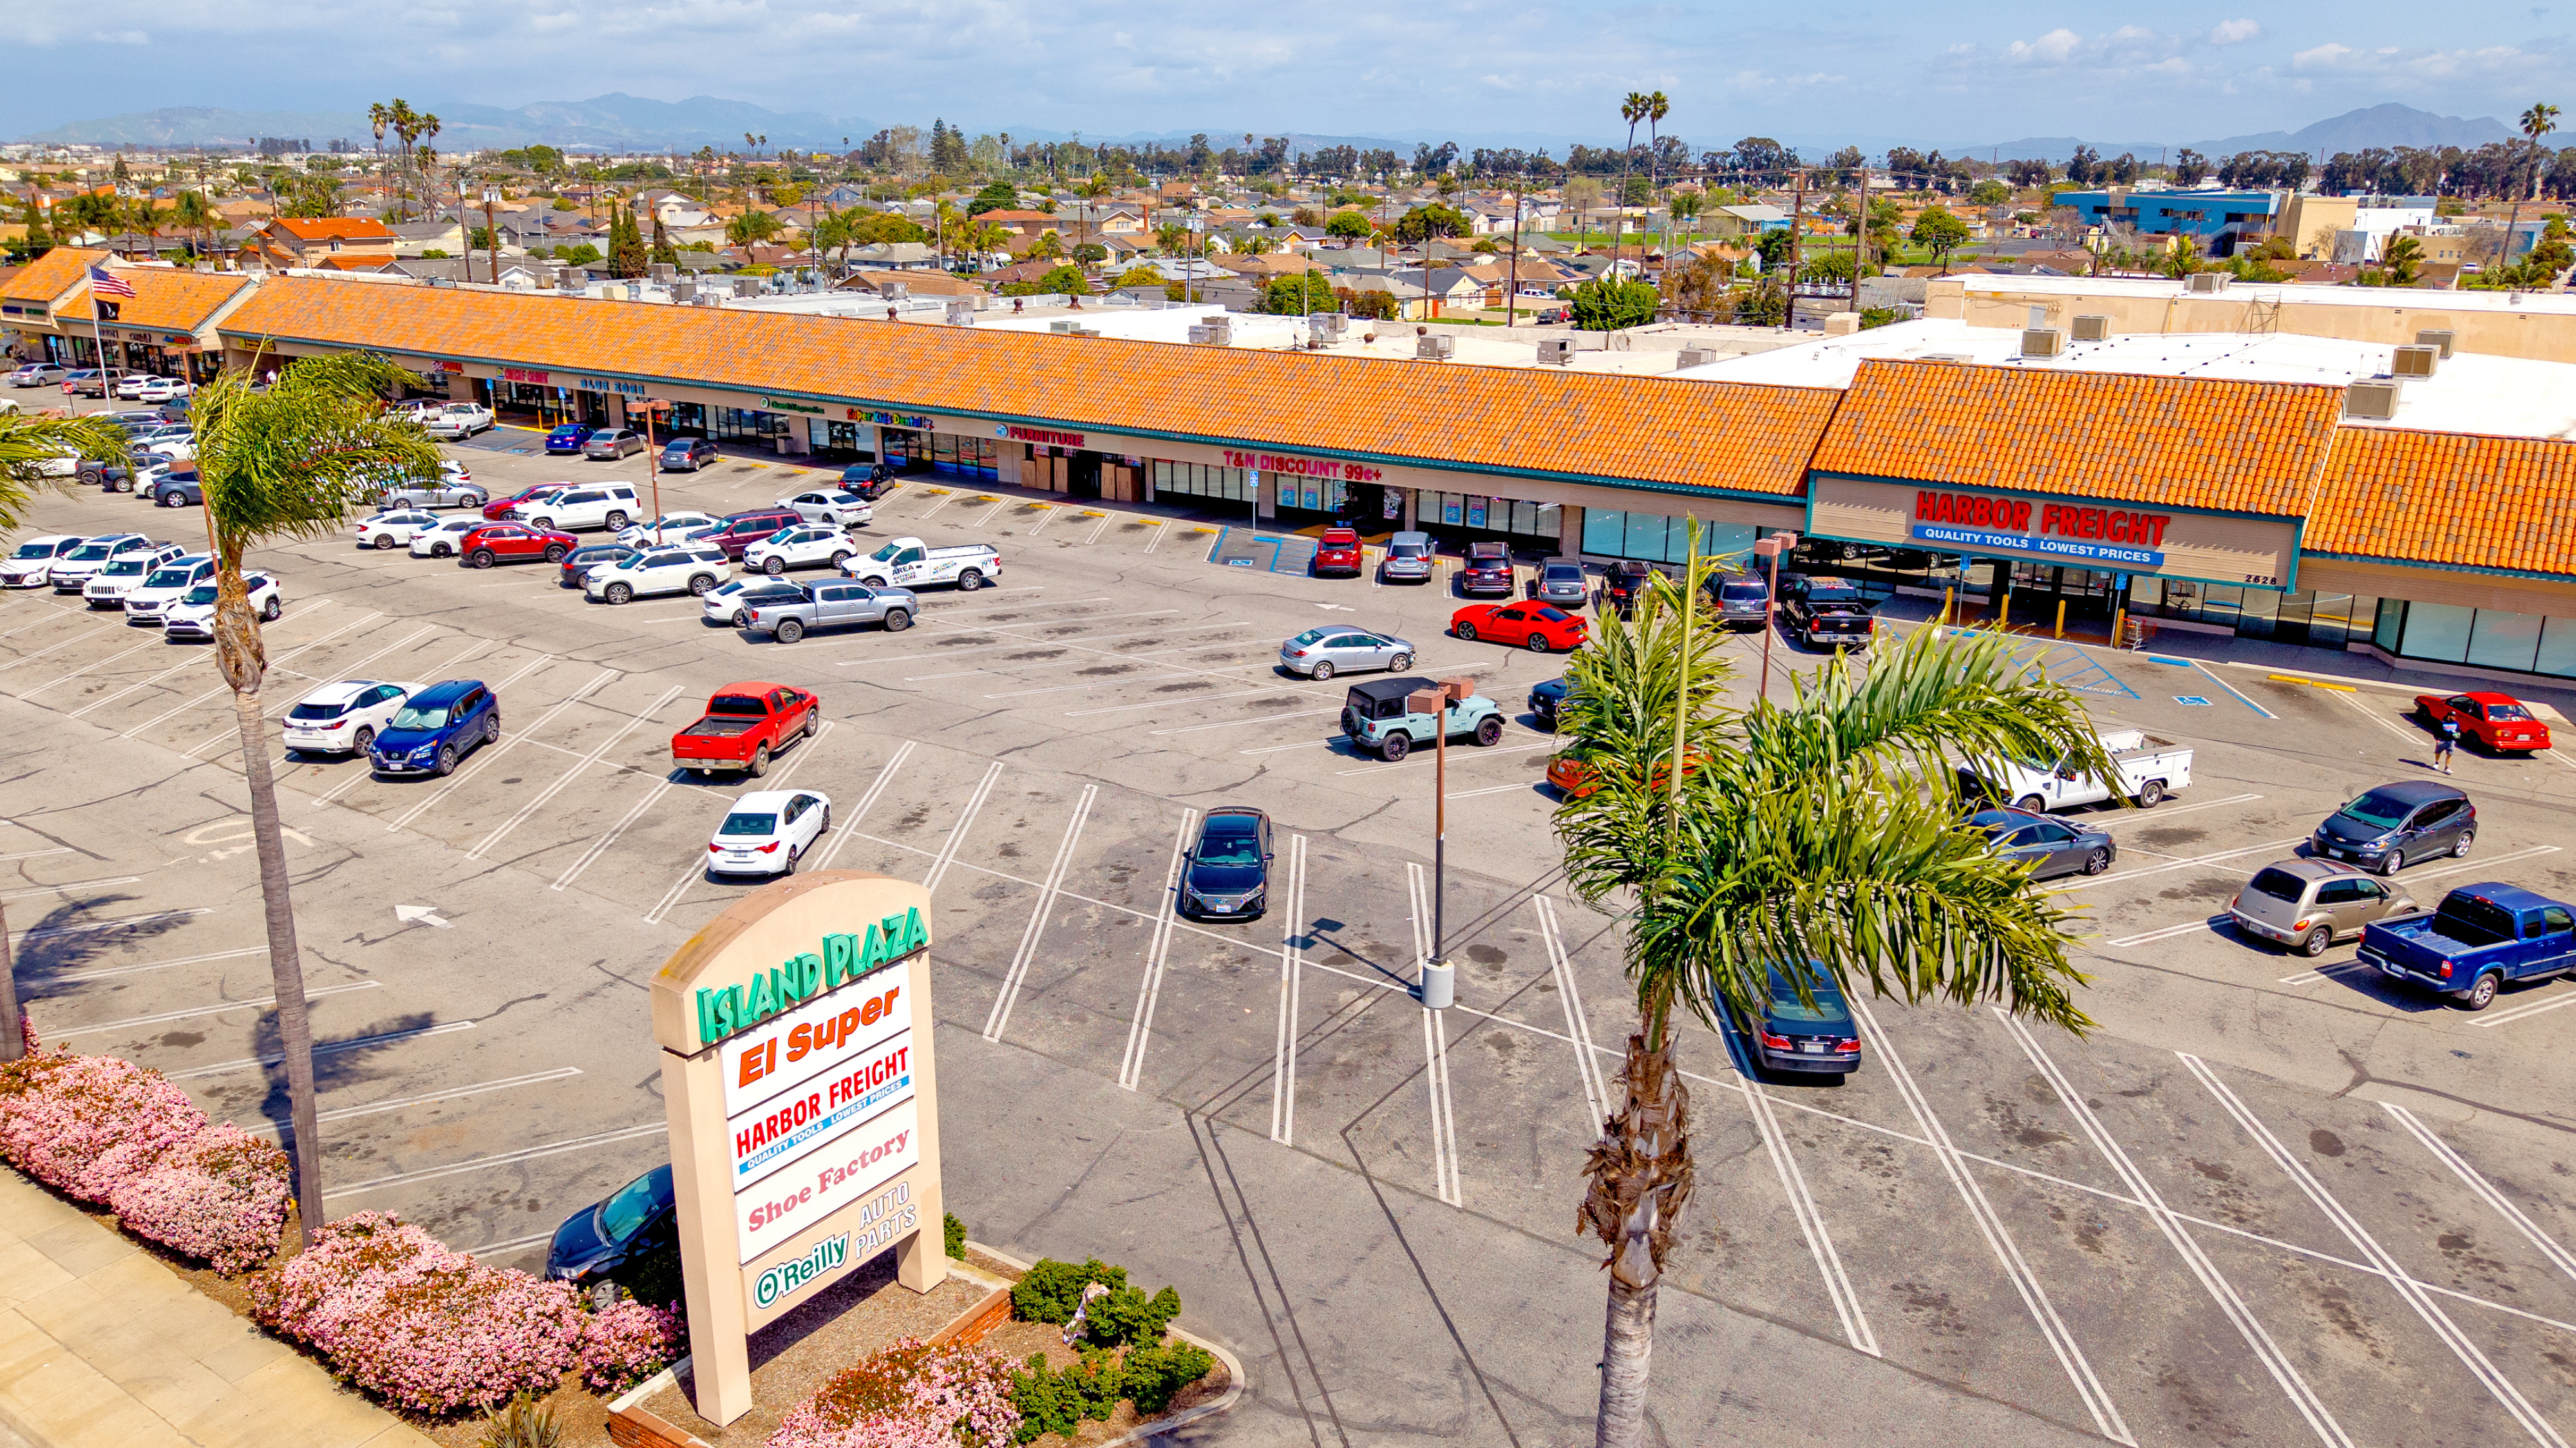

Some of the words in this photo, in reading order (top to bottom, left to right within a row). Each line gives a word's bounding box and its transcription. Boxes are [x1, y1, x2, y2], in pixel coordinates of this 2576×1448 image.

[581, 379, 609, 390] BLUE
[614, 382, 644, 394] ZONE
[847, 408, 871, 422] Super
[873, 412, 893, 424] Kids
[893, 413, 923, 428] Dental
[1010, 426, 1084, 447] FURNITURE
[1224, 451, 1255, 468] T&N
[1260, 455, 1340, 478] DISCOUNT
[1916, 491, 2031, 531] HARBOR
[2041, 504, 2170, 546] FREIGHT
[1925, 528, 1982, 545] QUALITY
[1985, 535, 2029, 549] TOOLS
[2039, 540, 2095, 557] LOWEST
[2098, 547, 2151, 562] PRICES
[893, 565, 914, 575] AREA
[2245, 575, 2278, 585] 2628
[696, 951, 823, 1043] ISLAND
[822, 907, 929, 986] PLAZA
[739, 1037, 777, 1089] El
[786, 986, 900, 1064] Super
[736, 1091, 822, 1159] HARBOR
[829, 1046, 909, 1110] FREIGHT
[746, 1139, 790, 1169] QUALITY
[791, 1122, 824, 1147] TOOLS
[830, 1099, 868, 1125] LOWEST
[870, 1080, 903, 1104] PRICES
[748, 1187, 811, 1233] Shoe
[818, 1128, 911, 1196] Factory
[859, 1181, 910, 1230] AUTO
[753, 1231, 850, 1309] O'Reilly
[855, 1203, 917, 1260] PARTS
